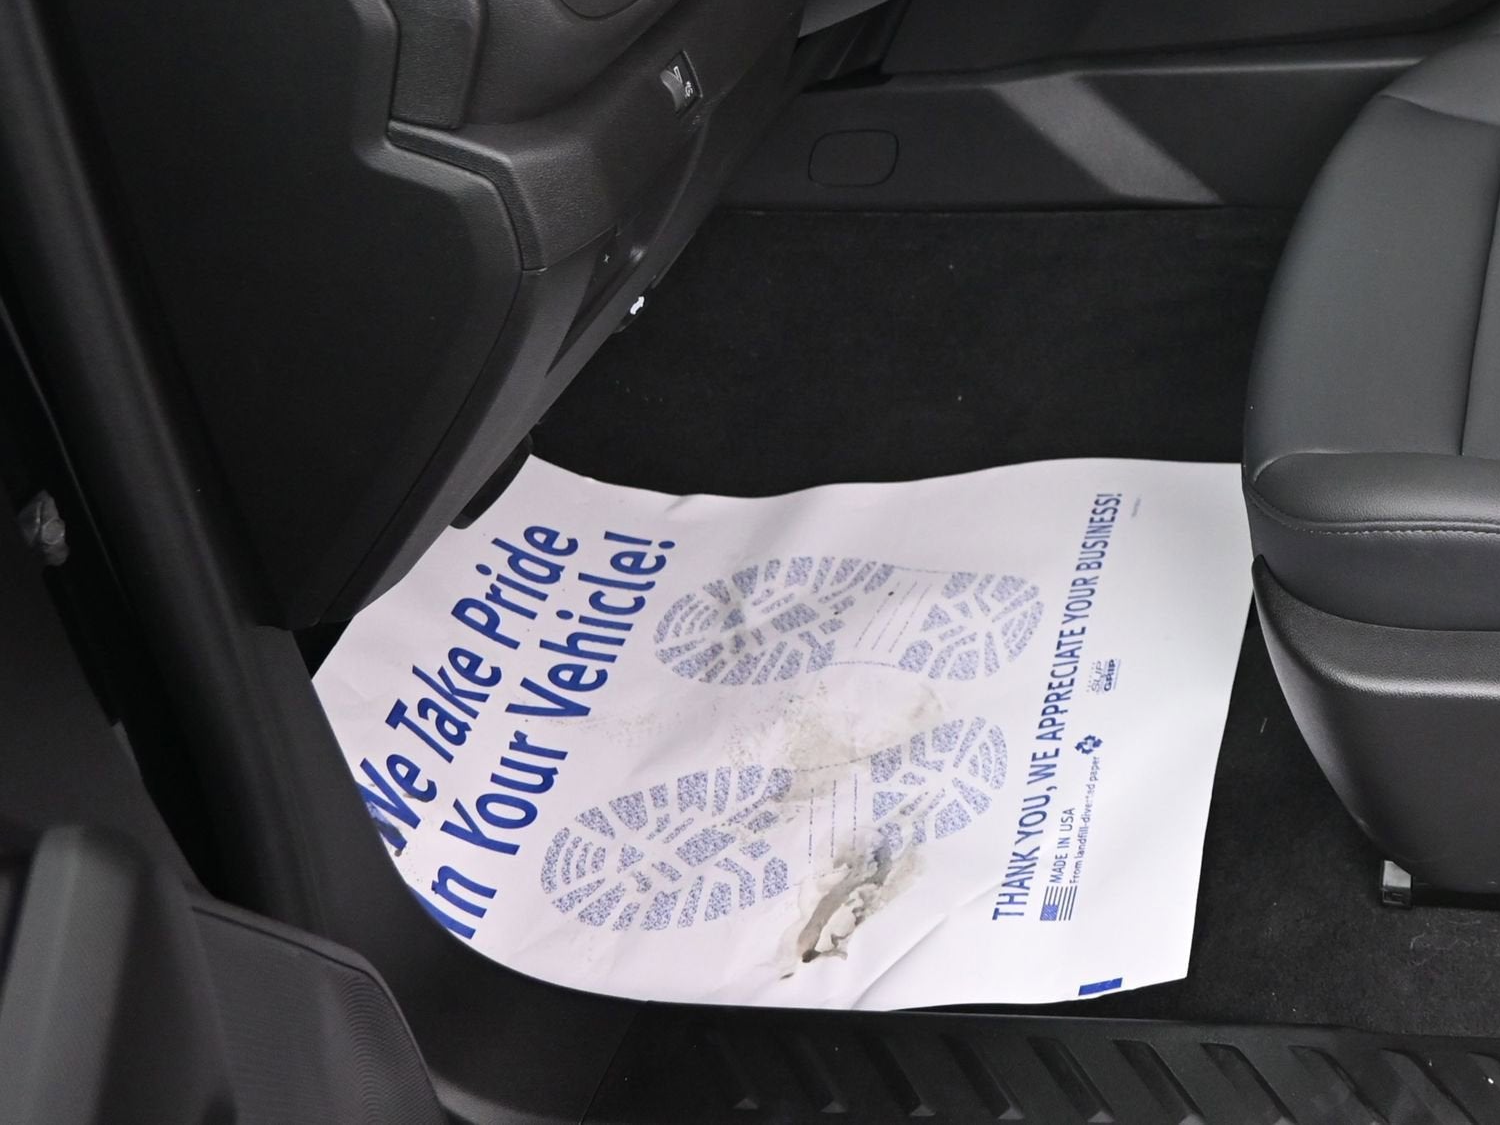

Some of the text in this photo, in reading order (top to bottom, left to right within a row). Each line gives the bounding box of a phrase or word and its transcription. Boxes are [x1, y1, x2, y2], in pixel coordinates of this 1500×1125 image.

[358, 524, 579, 851] We Take Pride
[409, 530, 677, 940] In Your Vehicle!
[992, 493, 1123, 921] THANK YOU, WE APPRECIATE YOUR BUSINESS!
[1103, 659, 1116, 692] GRIP
[1049, 807, 1075, 883] MADE IN USA
[1069, 860, 1083, 884] From
[1089, 756, 1101, 782] paper
